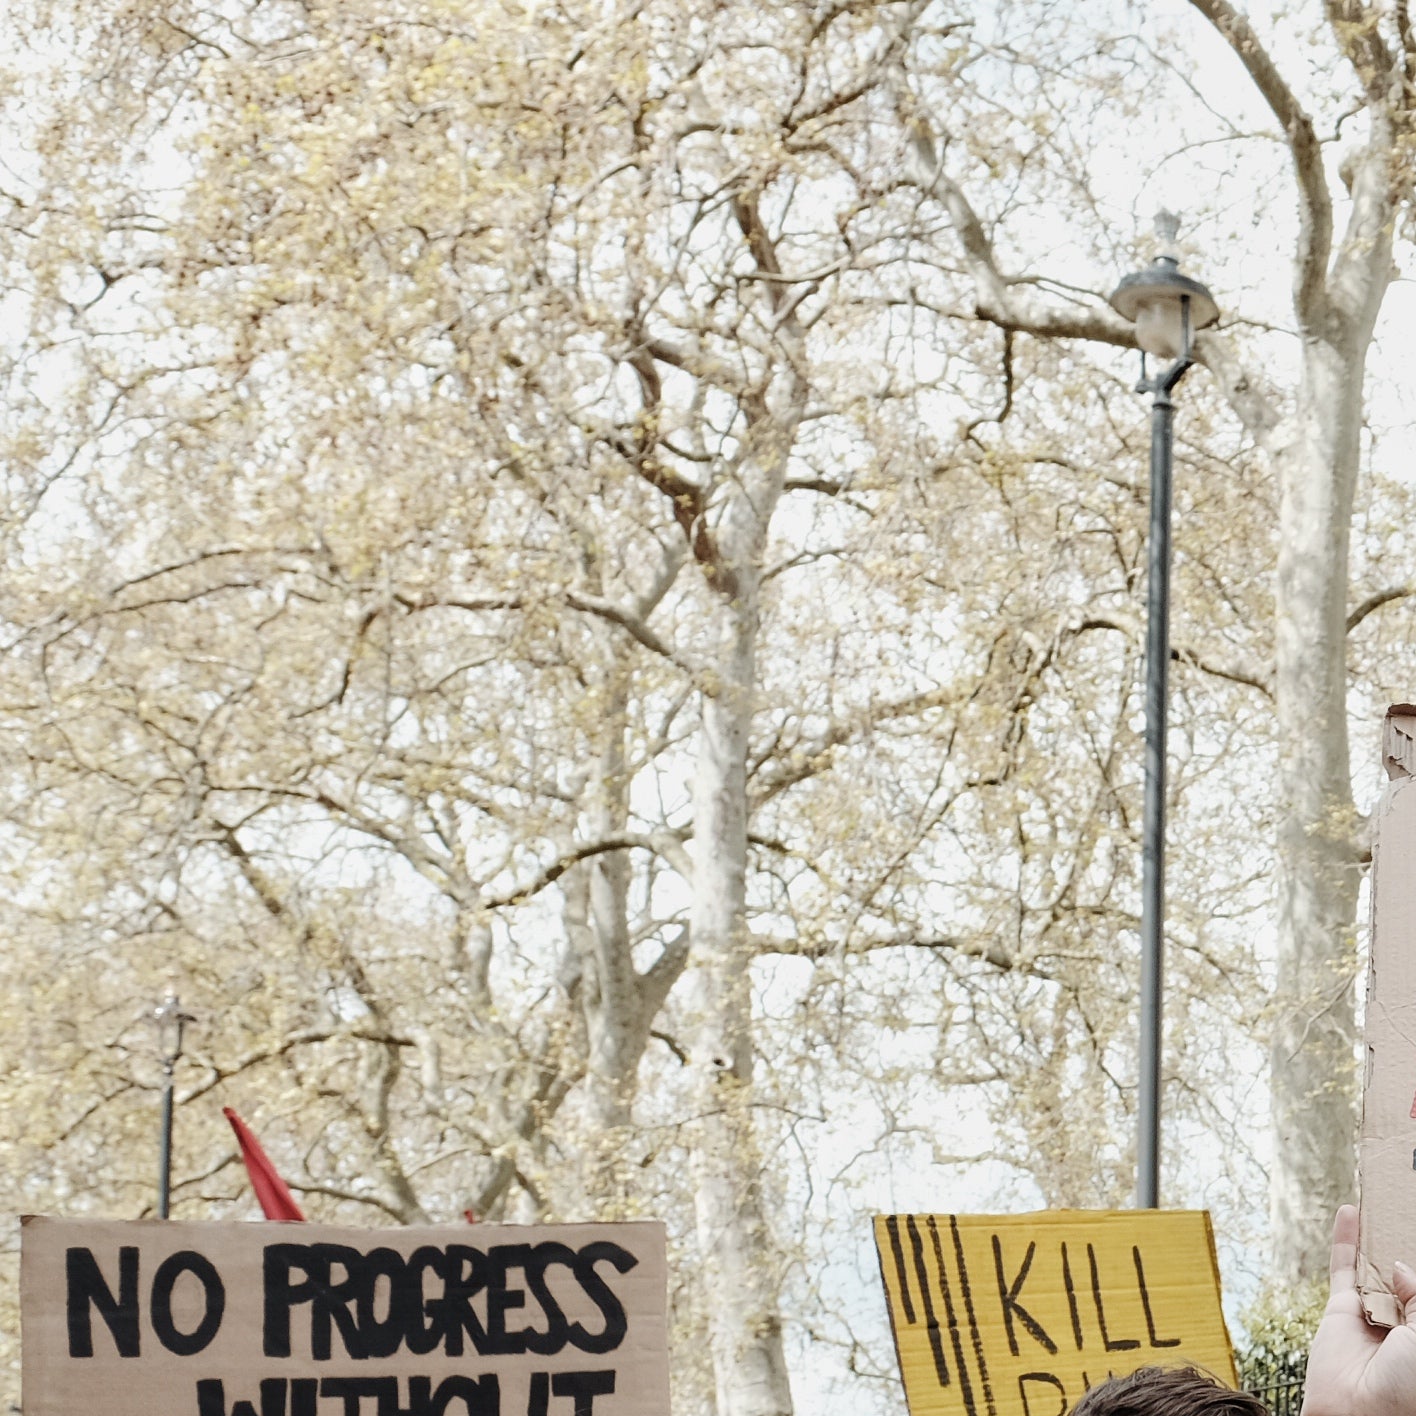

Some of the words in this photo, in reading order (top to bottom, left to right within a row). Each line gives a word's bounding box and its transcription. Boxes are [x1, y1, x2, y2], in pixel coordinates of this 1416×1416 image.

[65, 1246, 226, 1359] NO
[263, 1241, 640, 1360] PROGRESS
[991, 1234, 1182, 1357] KILL
